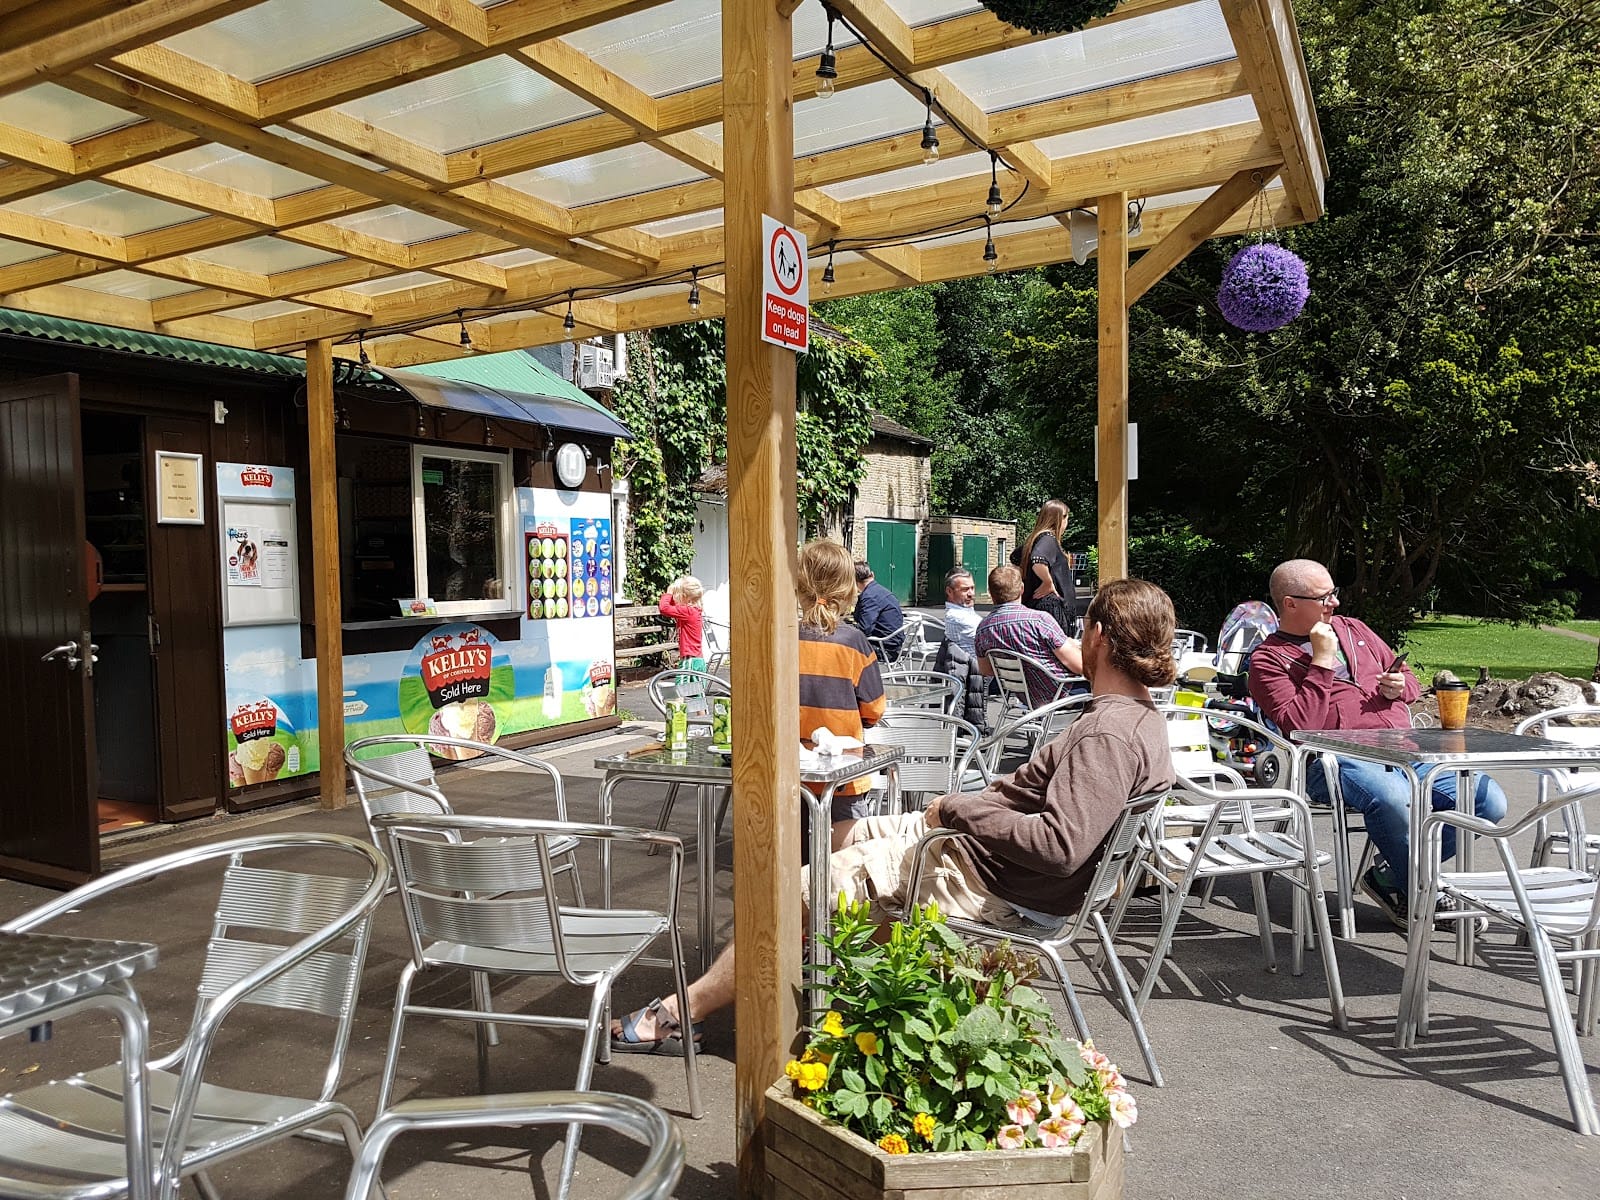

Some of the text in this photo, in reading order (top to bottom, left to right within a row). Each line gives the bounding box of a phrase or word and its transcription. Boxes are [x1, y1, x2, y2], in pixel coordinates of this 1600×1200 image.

[767, 299, 805, 325] Keep dogs
[772, 323, 799, 340] on lead
[243, 474, 271, 483] KELLY'S
[427, 648, 487, 678] KELLY'S
[450, 667, 476, 677] CORNWALL
[440, 682, 482, 701] Sold Here
[235, 710, 274, 728] KELLY'S
[242, 729, 270, 741] Sold Here
